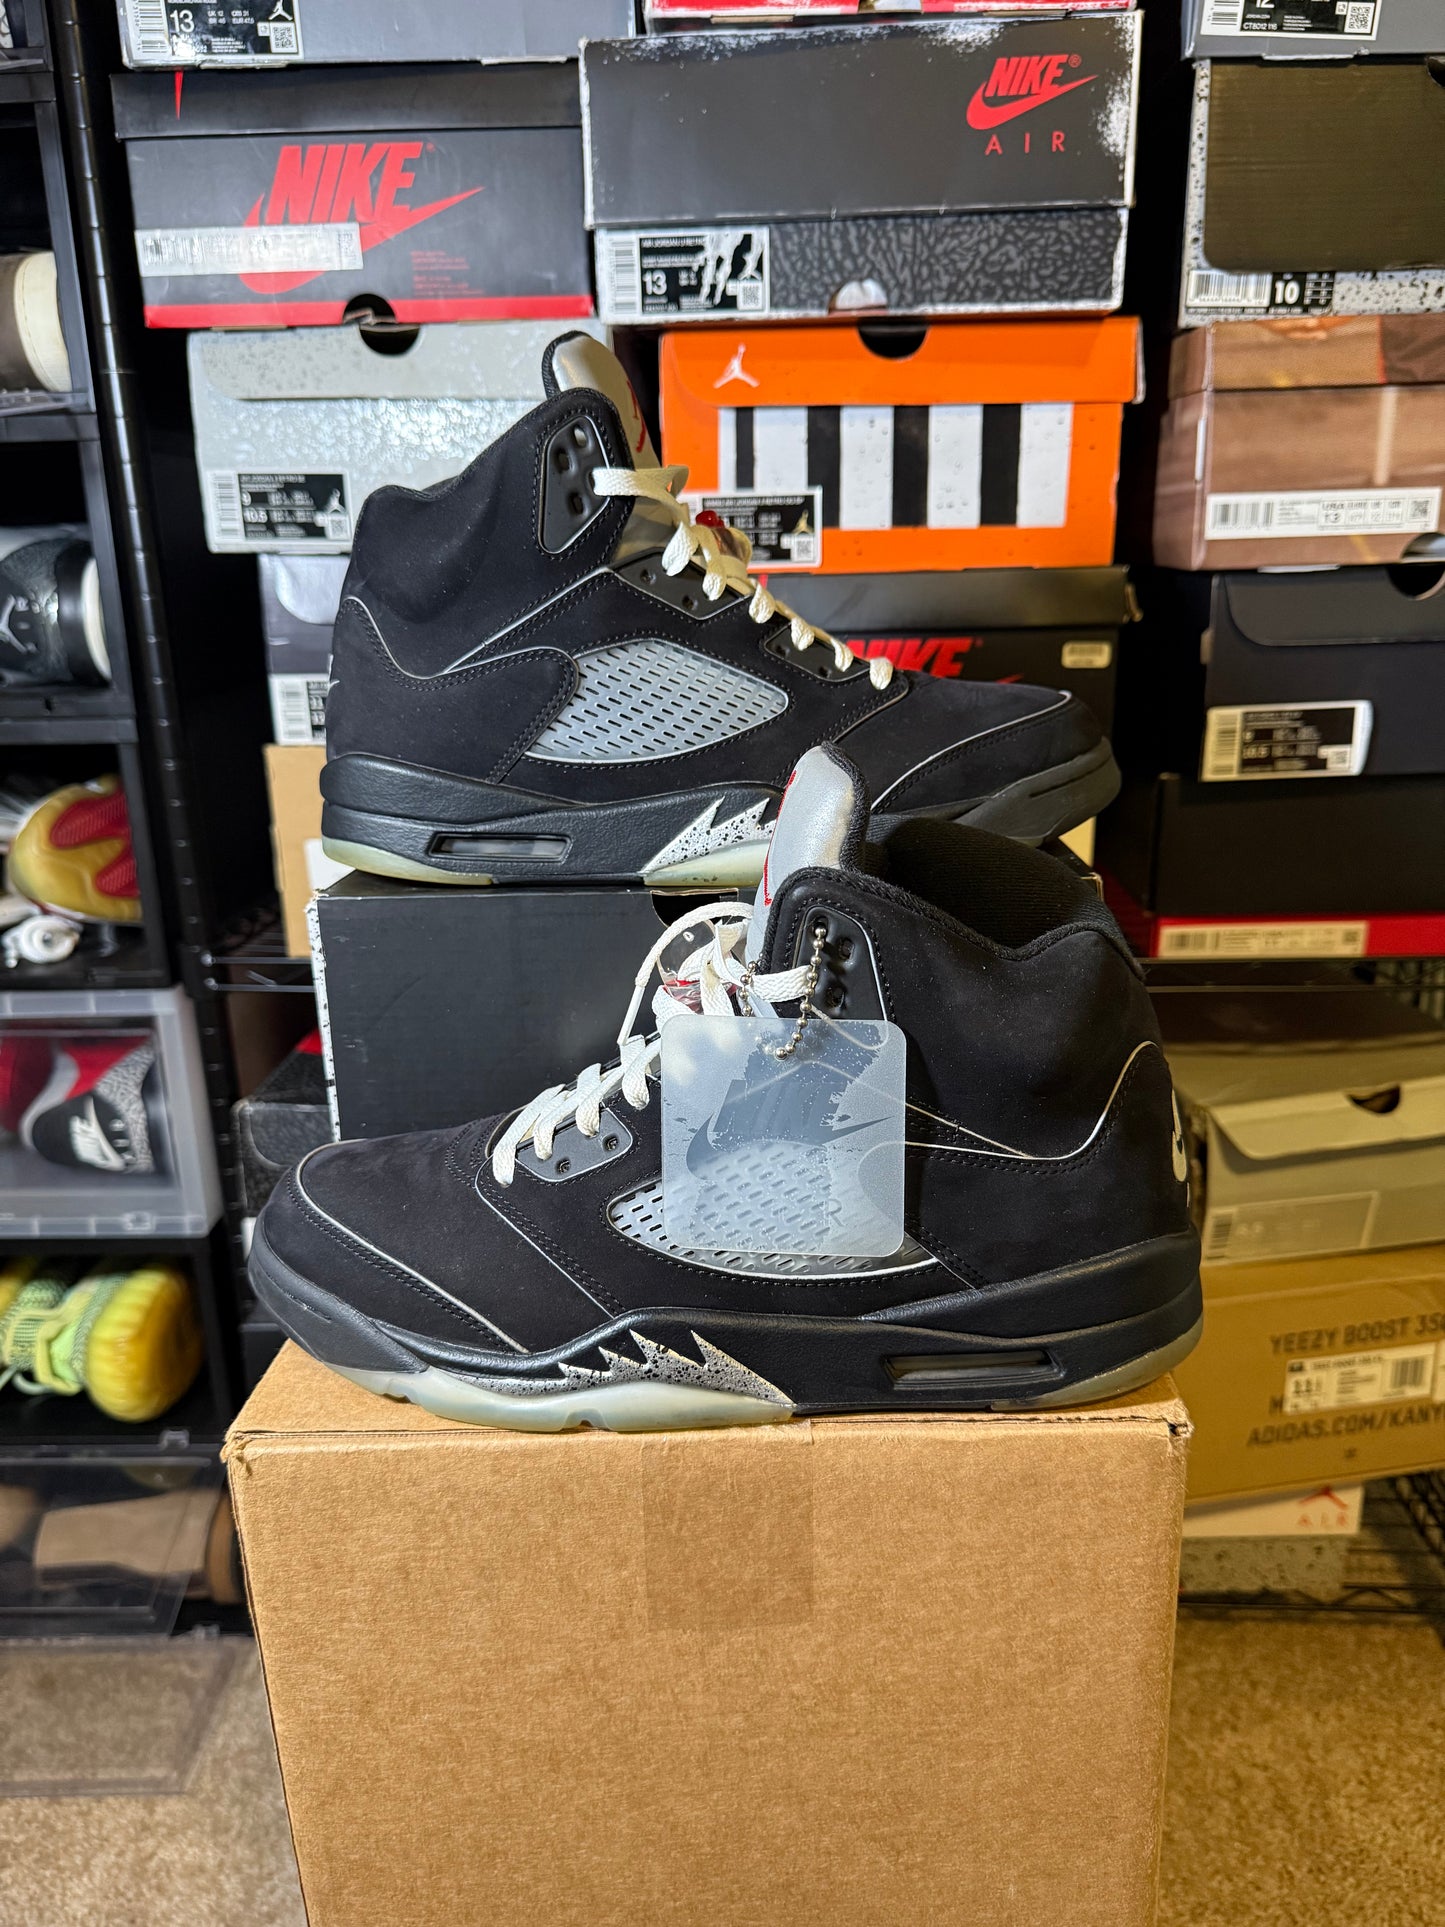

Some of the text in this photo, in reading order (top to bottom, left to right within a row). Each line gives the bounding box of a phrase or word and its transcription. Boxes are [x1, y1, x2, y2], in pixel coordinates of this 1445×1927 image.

[169, 9, 195, 33] 13
[985, 54, 1069, 98] NIKE
[984, 131, 1065, 156] AIR
[265, 142, 423, 226] NIKE
[642, 269, 668, 295] 13
[1274, 280, 1300, 305] 10
[1271, 1327, 1338, 1353] YEEZY
[1343, 1316, 1409, 1346] BOOST
